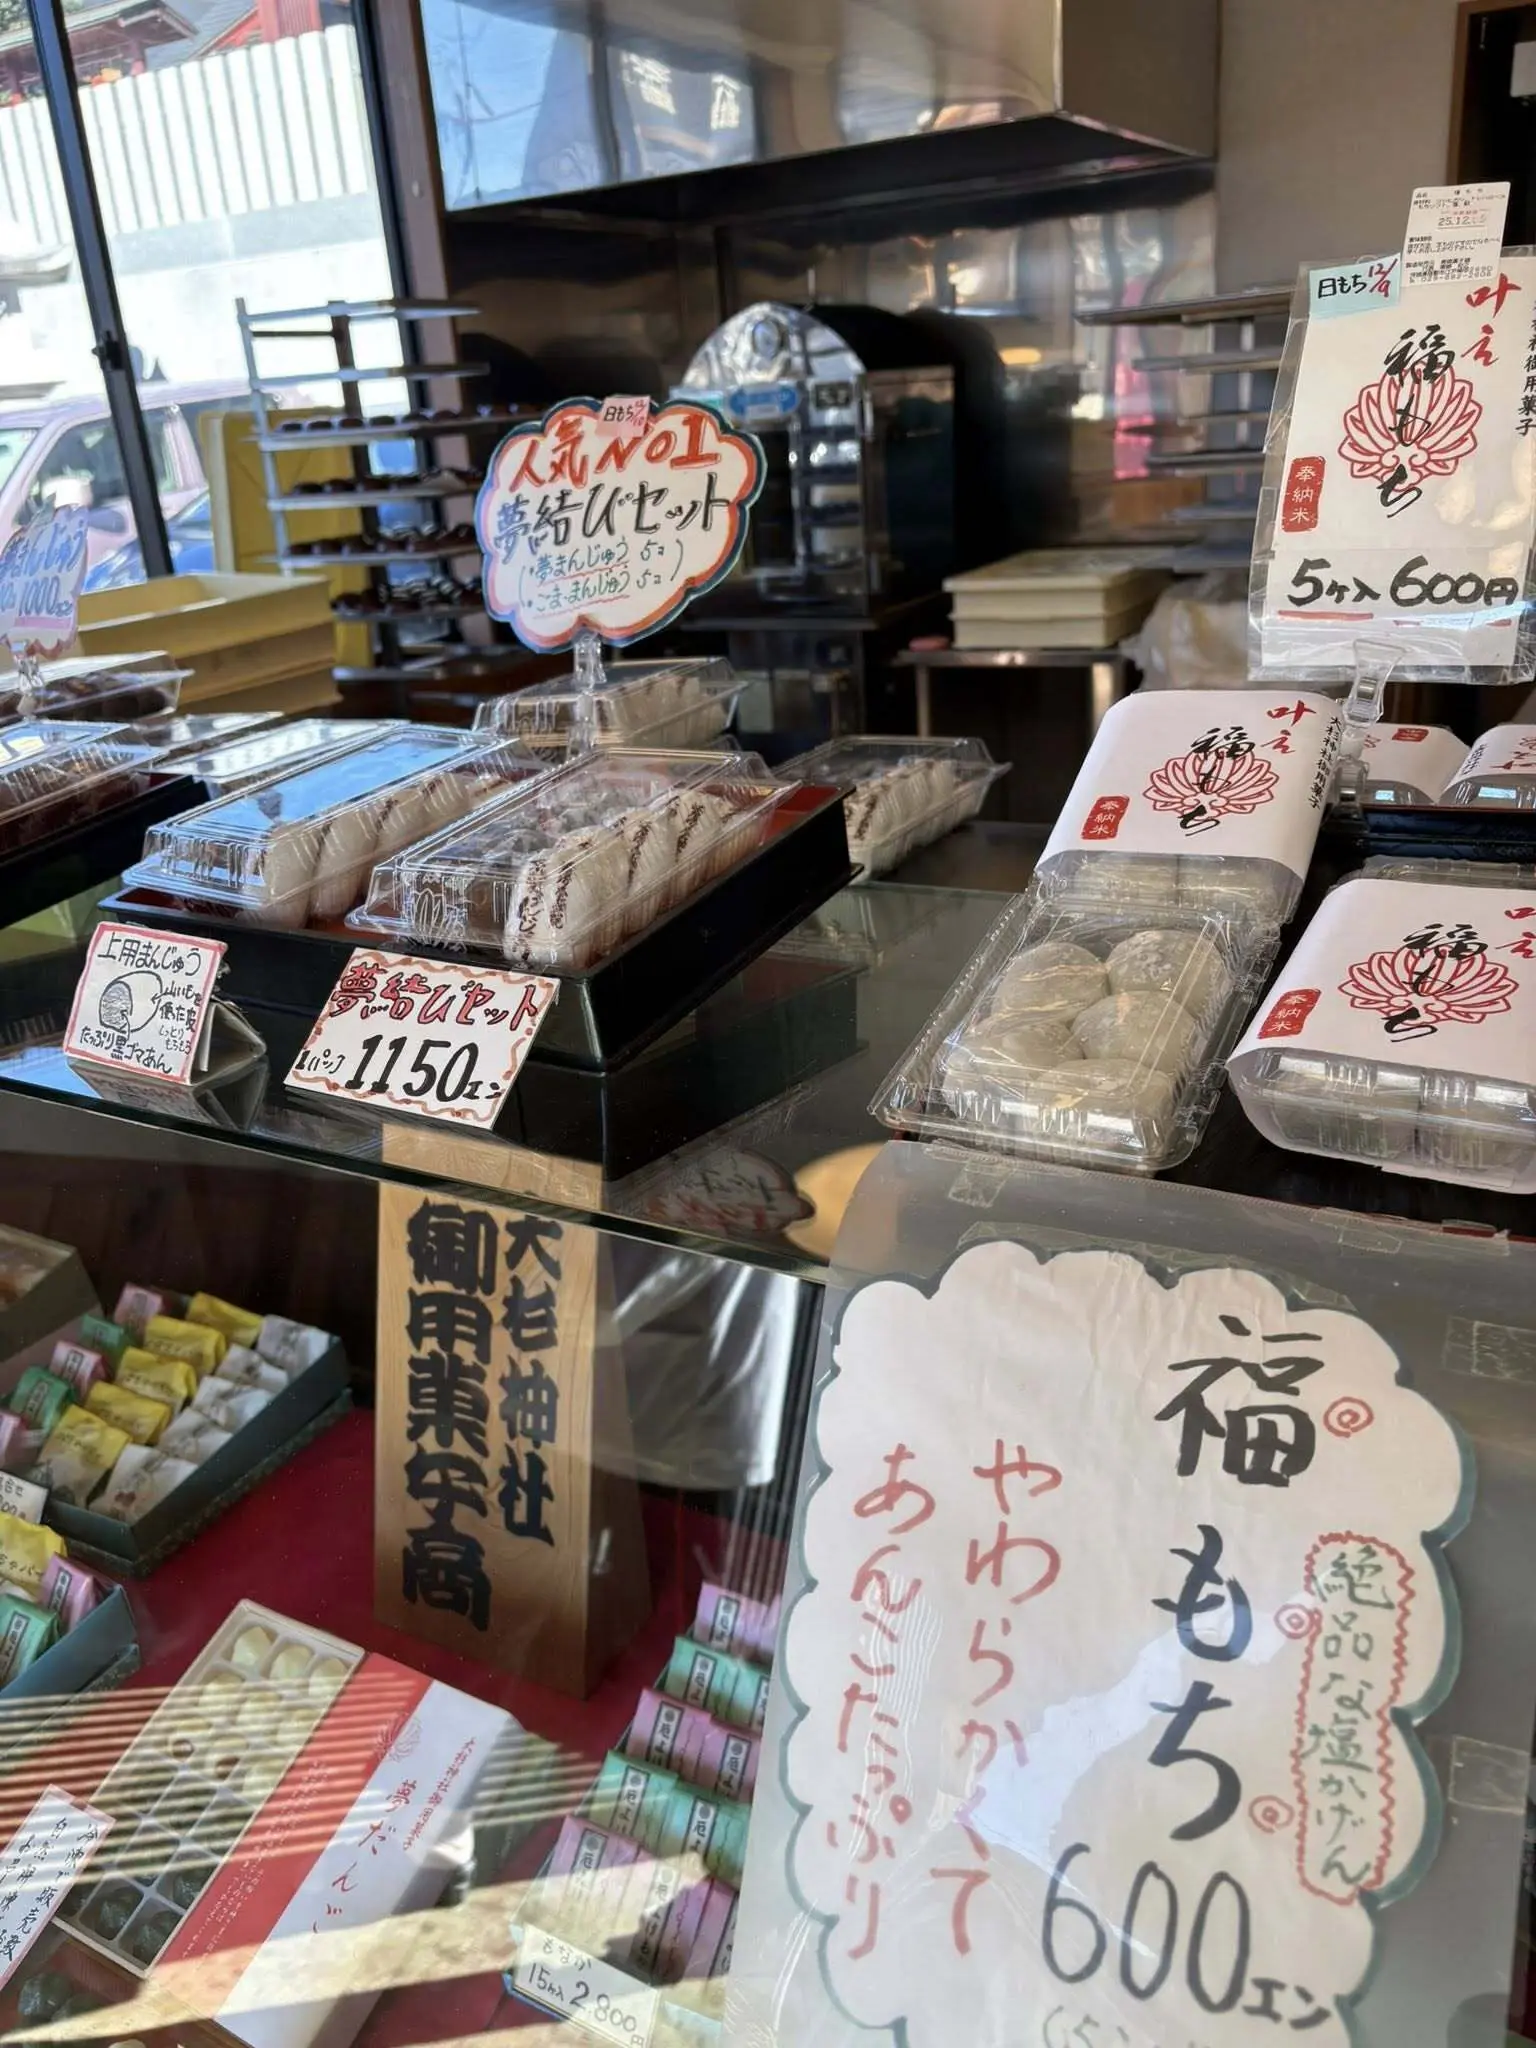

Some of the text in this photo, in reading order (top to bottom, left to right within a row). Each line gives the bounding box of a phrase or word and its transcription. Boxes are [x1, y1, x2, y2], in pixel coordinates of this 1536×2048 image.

[494, 472, 730, 564] 夢結びセット
[1288, 464, 1317, 525] 奉納米
[1390, 555, 1519, 608] 600円
[1260, 700, 1317, 755] 叶え
[1090, 801, 1118, 835] 奉納米
[97, 931, 202, 977] 上用まんじゅう
[328, 961, 539, 1031] 夢結びセット
[80, 1024, 173, 1074] たっぷり黒ゴマあん
[500, 1213, 563, 1548] 大杉神社
[1149, 1314, 1324, 1841] 福もち
[826, 1443, 936, 1961] あんこたっぷり
[930, 1438, 1063, 1957] やわらかくて
[1299, 1544, 1396, 1886] 絶品な塩かげん
[1041, 1842, 1333, 2030] 600エン
